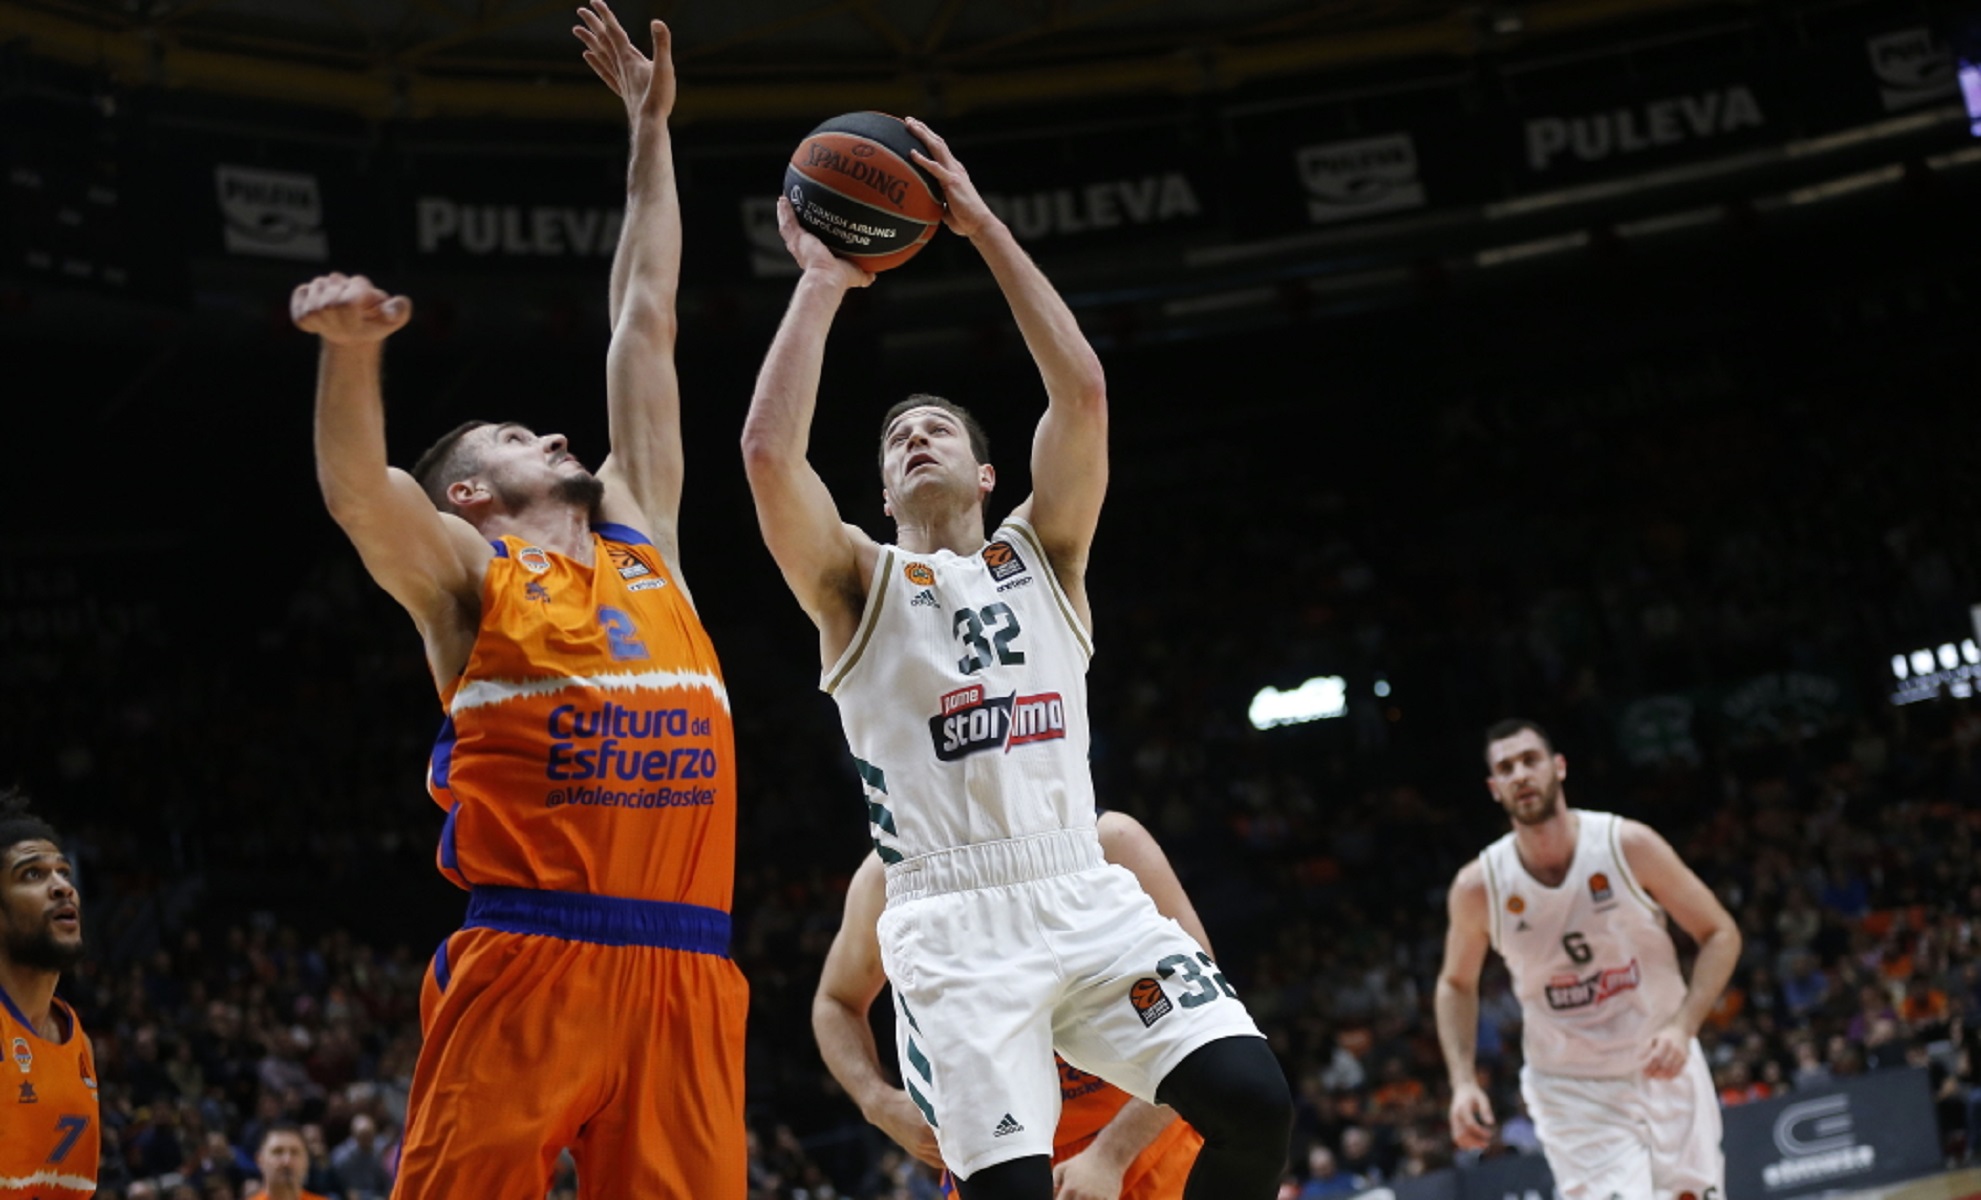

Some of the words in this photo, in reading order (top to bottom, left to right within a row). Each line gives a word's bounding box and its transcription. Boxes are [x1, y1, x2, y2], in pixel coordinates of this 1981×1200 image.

[1524, 83, 1766, 172] PULEVA
[803, 143, 909, 206] SPALDING
[806, 200, 849, 228] TURKISH
[849, 223, 897, 238] AIRLINES
[597, 604, 651, 661] 2
[953, 602, 1025, 675] 32
[547, 701, 687, 739] Cultura
[691, 717, 712, 737] del
[546, 739, 717, 781] Esfuerzo
[1562, 931, 1593, 966] 6
[47, 1113, 91, 1164] 7
